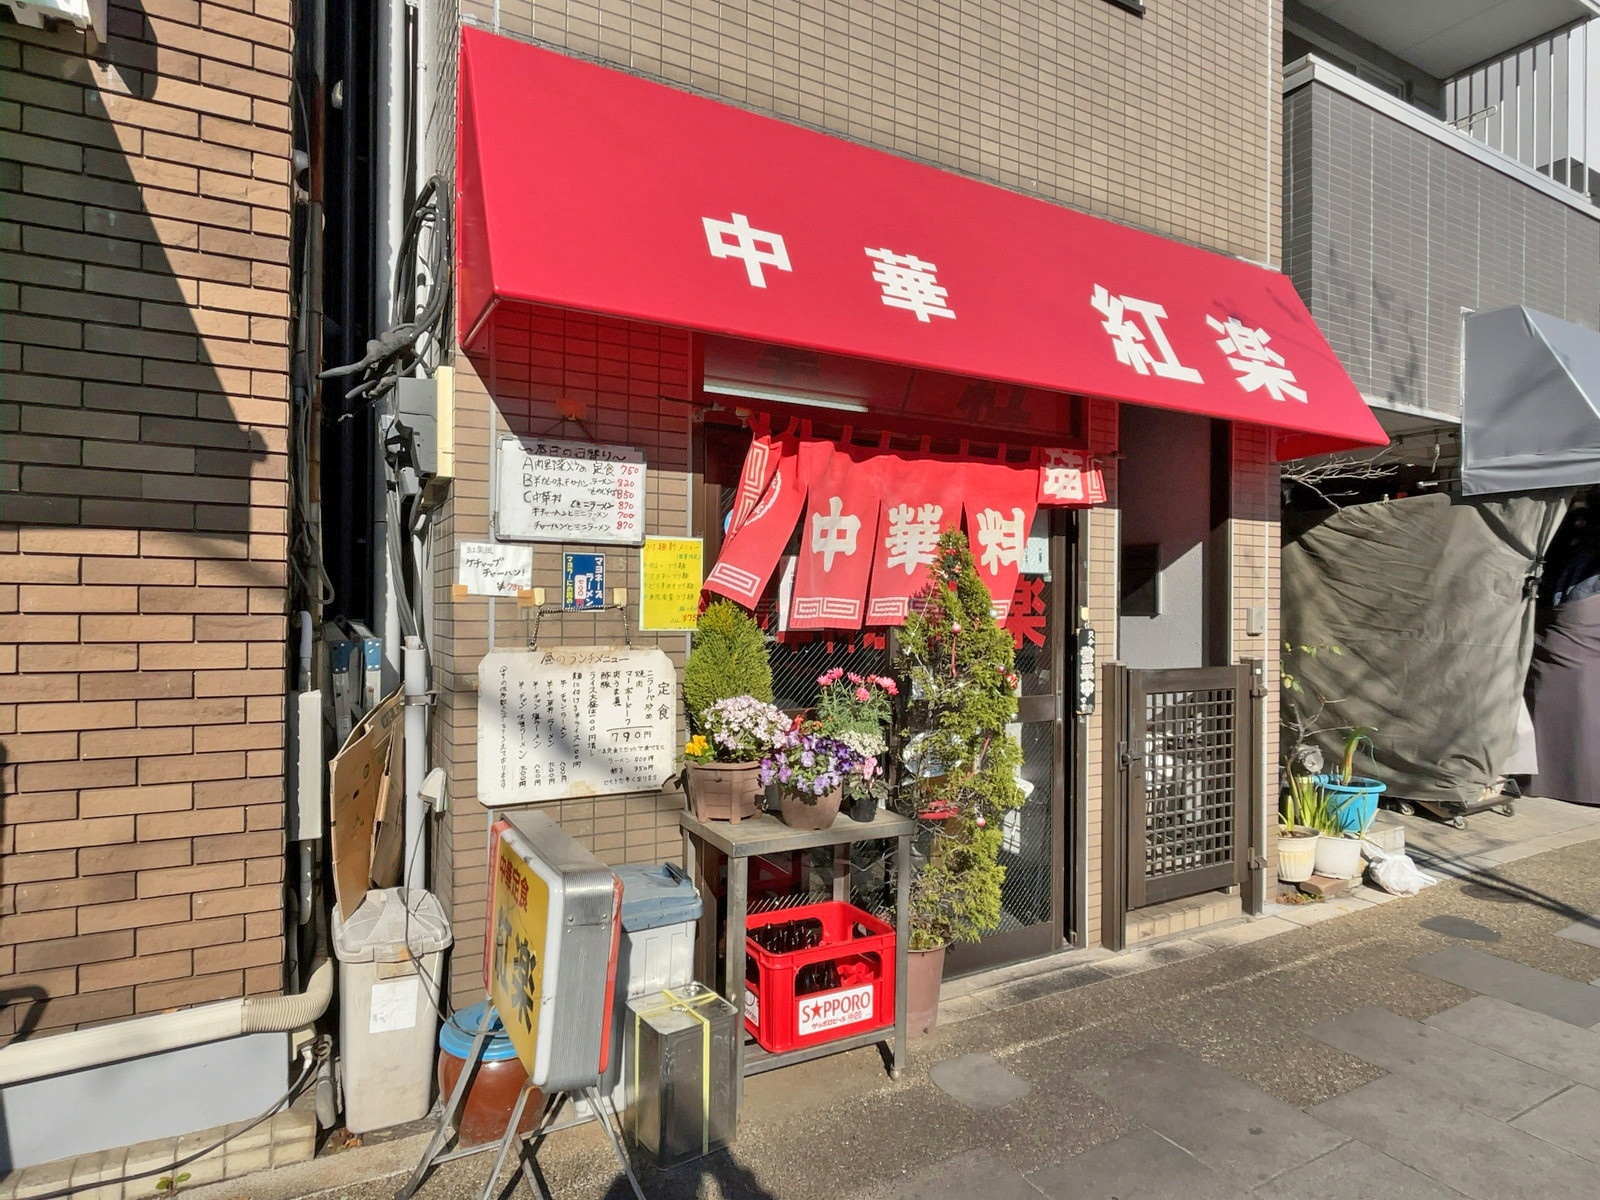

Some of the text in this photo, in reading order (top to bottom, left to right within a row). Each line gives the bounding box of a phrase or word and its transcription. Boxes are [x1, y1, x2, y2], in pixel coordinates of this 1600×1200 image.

[702, 212, 1308, 404] 中華 紅楽
[620, 464, 639, 475] 750
[617, 478, 635, 488] 820
[616, 489, 635, 499] 850
[618, 501, 634, 510] 870
[616, 511, 635, 520] 700
[616, 521, 634, 530] 870
[466, 557, 504, 568] ケチャップ
[585, 573, 594, 606] ラーメン
[541, 652, 630, 665] 昼のランチメニュー
[635, 669, 646, 688] 焼肉
[657, 682, 670, 720] 定食
[611, 730, 651, 742] 790円
